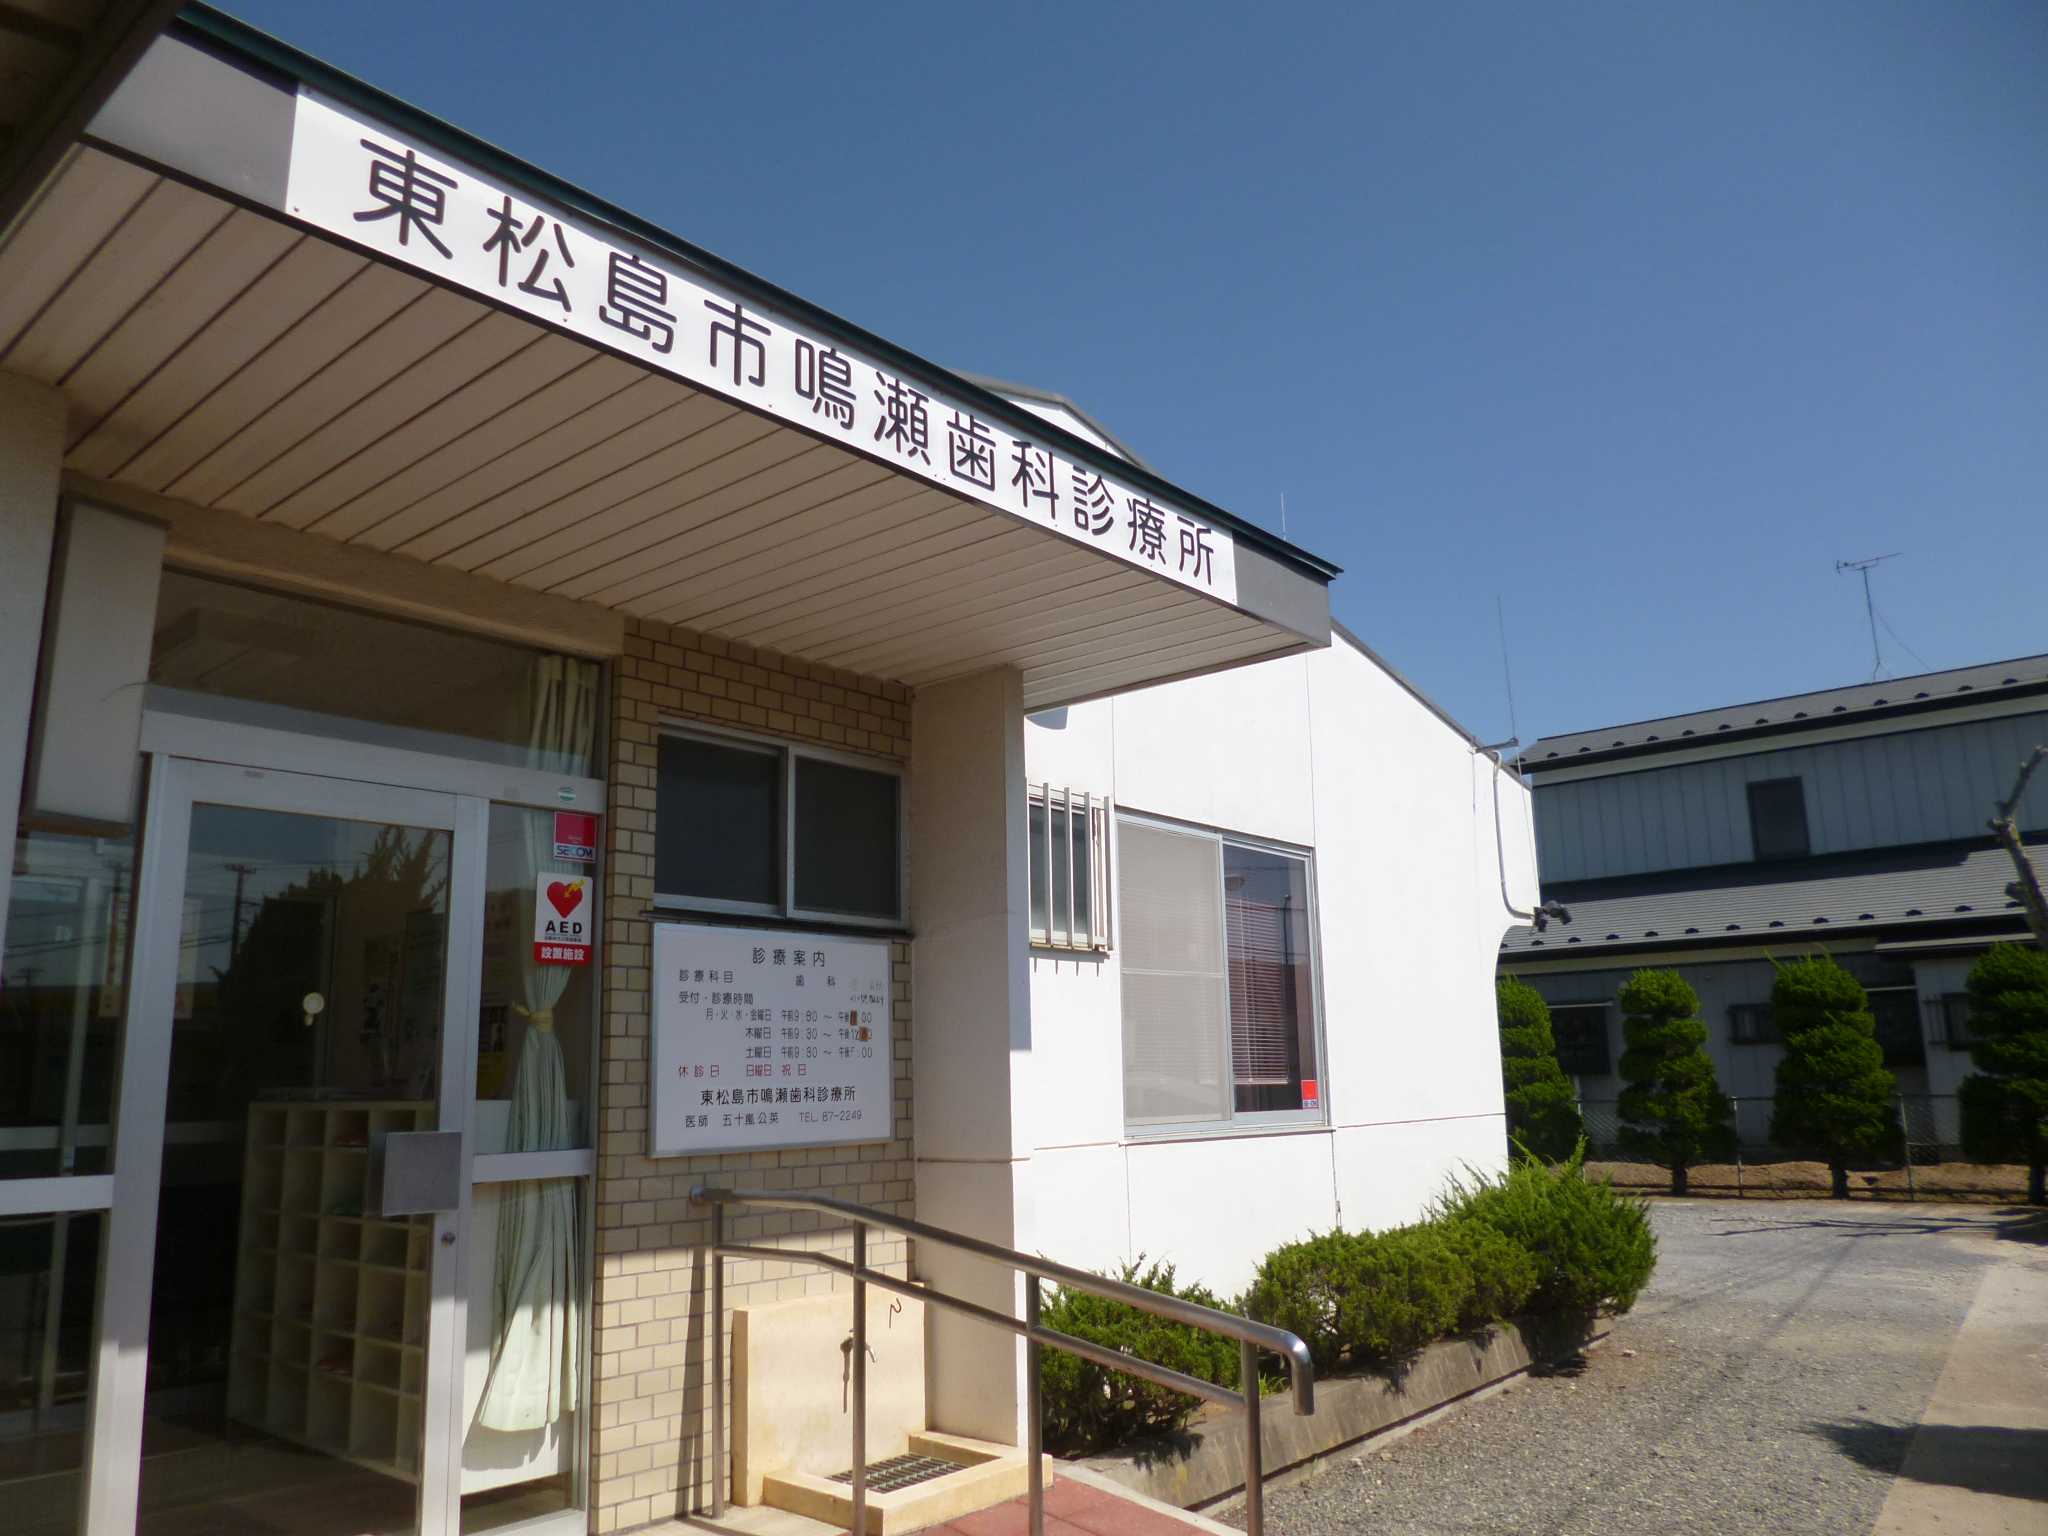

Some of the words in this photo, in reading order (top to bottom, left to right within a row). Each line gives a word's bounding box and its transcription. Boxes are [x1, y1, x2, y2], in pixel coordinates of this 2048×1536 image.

[354, 137, 1216, 587] 東松島市鳴瀬歯科診療所
[557, 845, 594, 858] SECOM
[545, 920, 583, 934] AED
[541, 947, 585, 961] 設置施設
[752, 947, 826, 967] 診療案内
[679, 969, 733, 983] 診療科目
[745, 1027, 771, 1039] 木曜日
[745, 1046, 772, 1059] 土曜日
[678, 1064, 720, 1078] 休診日
[746, 1064, 772, 1077] 日曜日
[700, 1085, 856, 1106] 東松島市鳴瀬歯科診療所
[685, 1114, 709, 1128] 医師
